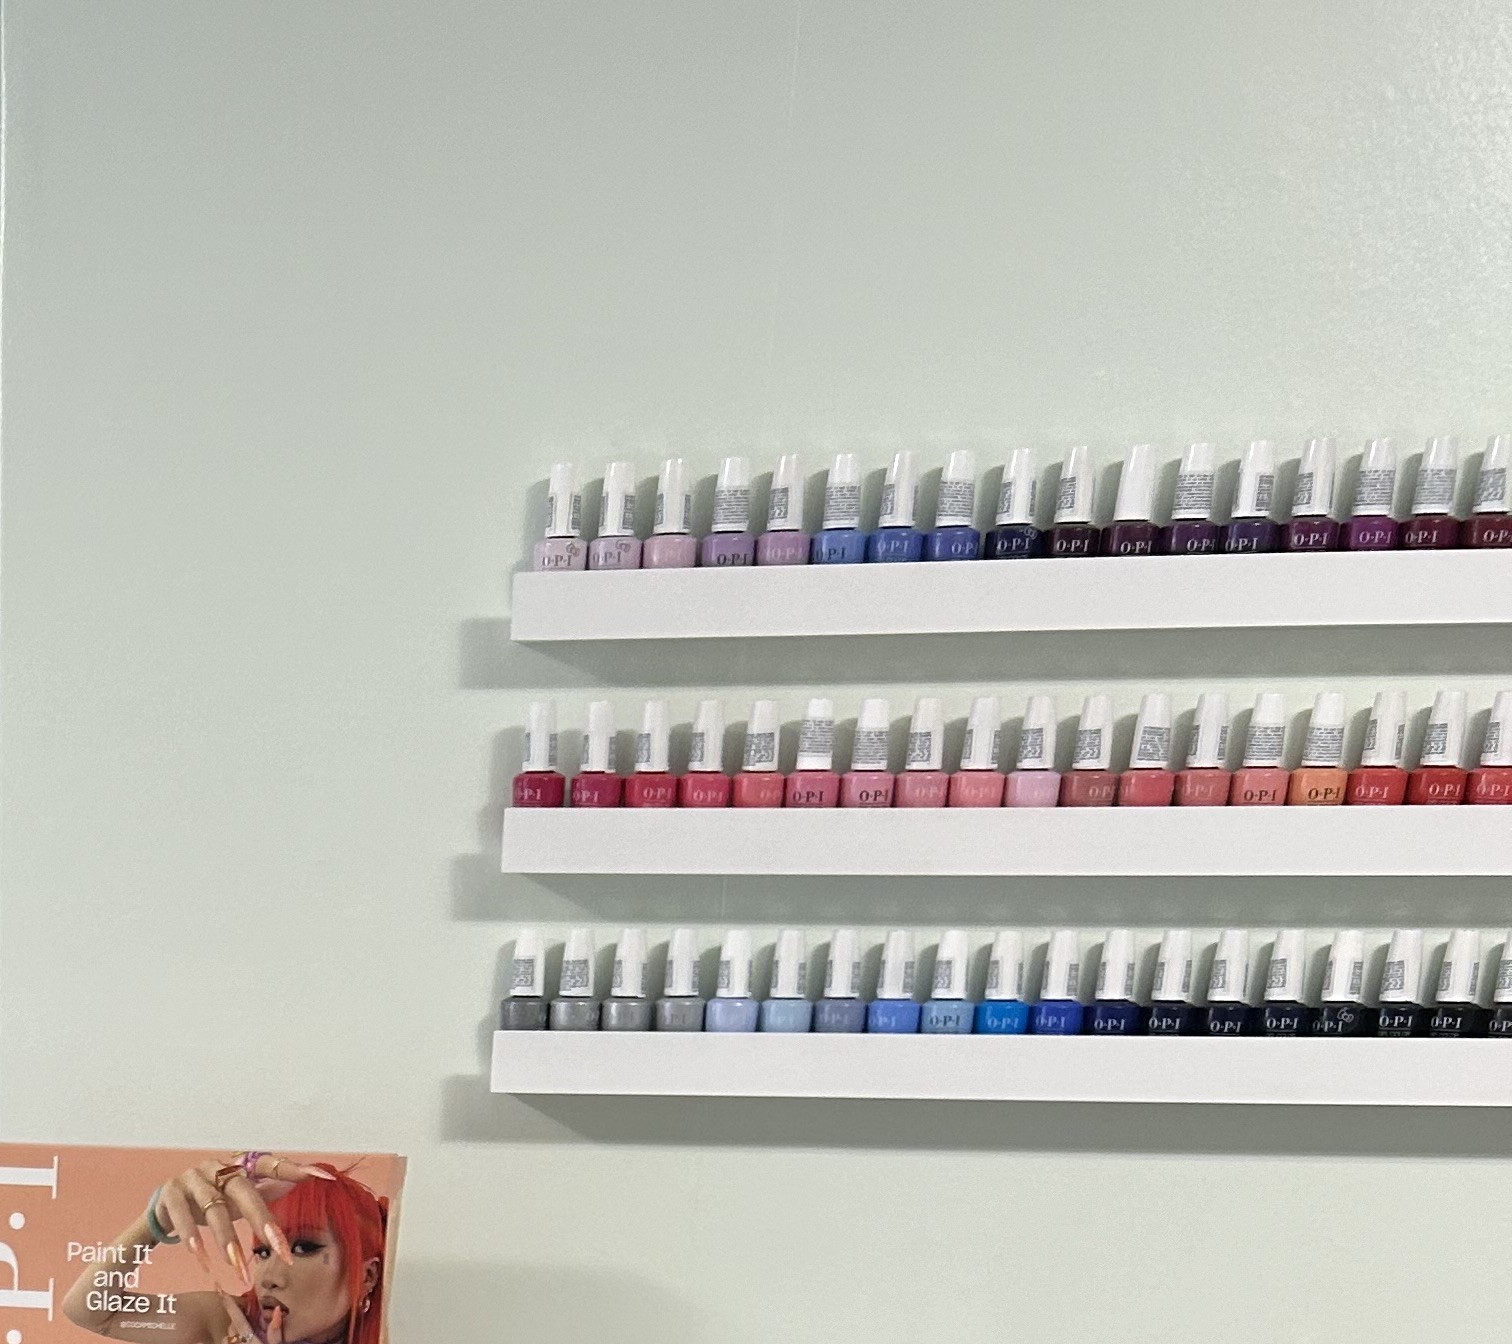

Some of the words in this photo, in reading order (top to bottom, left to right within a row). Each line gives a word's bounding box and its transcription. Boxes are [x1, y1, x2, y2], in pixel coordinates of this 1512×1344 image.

[66, 1241, 126, 1264] Paint
[132, 1243, 153, 1265] It
[92, 1267, 139, 1289] and
[85, 1290, 151, 1313] Glaze
[156, 1293, 178, 1315] It
